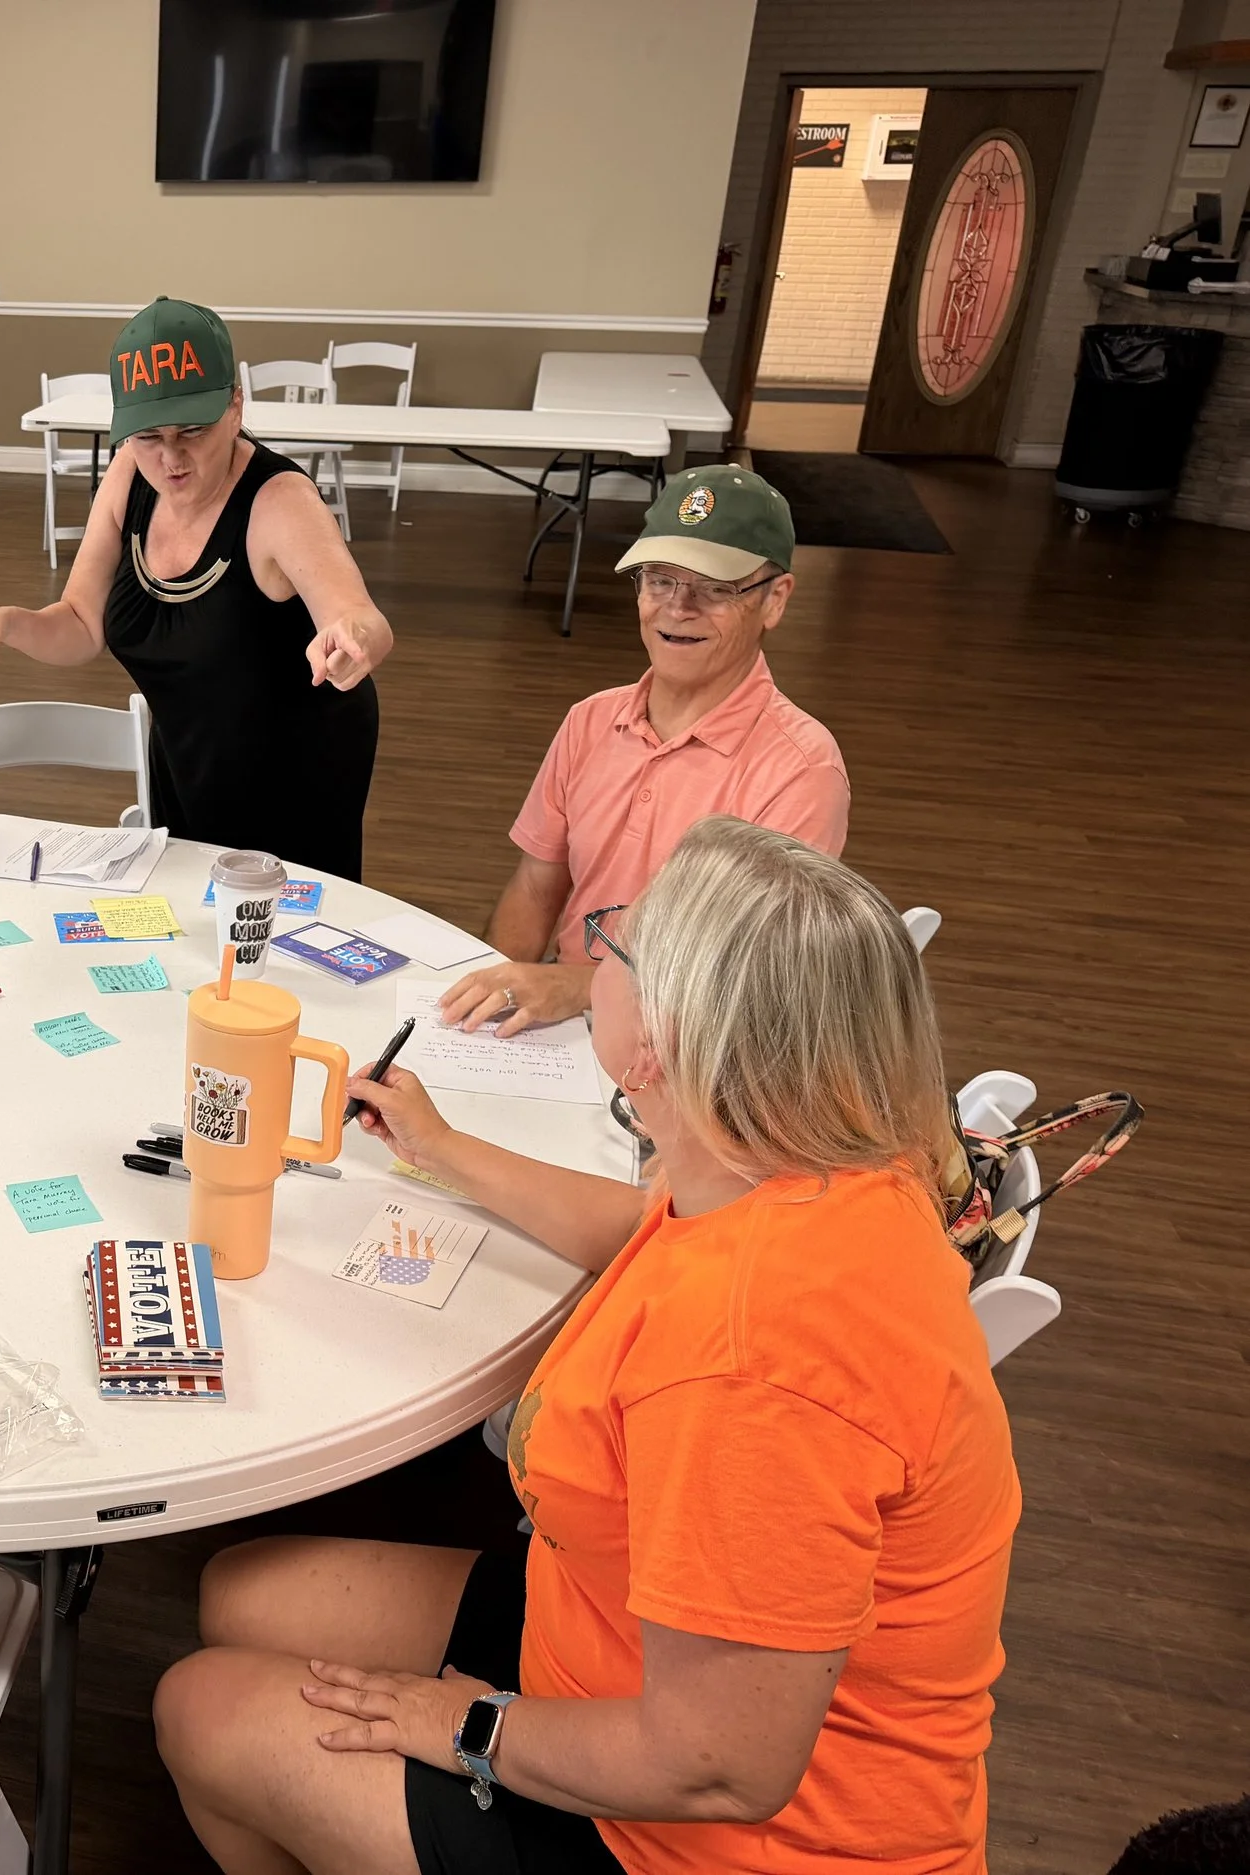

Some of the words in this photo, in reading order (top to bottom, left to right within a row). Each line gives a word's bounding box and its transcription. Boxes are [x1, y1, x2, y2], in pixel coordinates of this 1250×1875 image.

[117, 340, 205, 393] TARA
[237, 898, 274, 920] ONE
[71, 931, 105, 939] VOTE
[231, 918, 274, 942] MORE
[237, 942, 266, 963] CUP
[529, 1070, 563, 1080] Dear
[197, 1102, 236, 1121] BOOKS
[196, 1112, 216, 1126] HELP
[218, 1119, 235, 1131] ME
[196, 1122, 235, 1142] GROW
[13, 1190, 20, 1200] A
[24, 1184, 46, 1195] vote
[48, 1181, 65, 1190] for
[15, 1197, 38, 1205] Tara
[43, 1188, 76, 1200] Murray
[46, 1199, 67, 1207] vote
[126, 1246, 172, 1343] VOTE
[106, 1504, 158, 1519] LIFETIME
